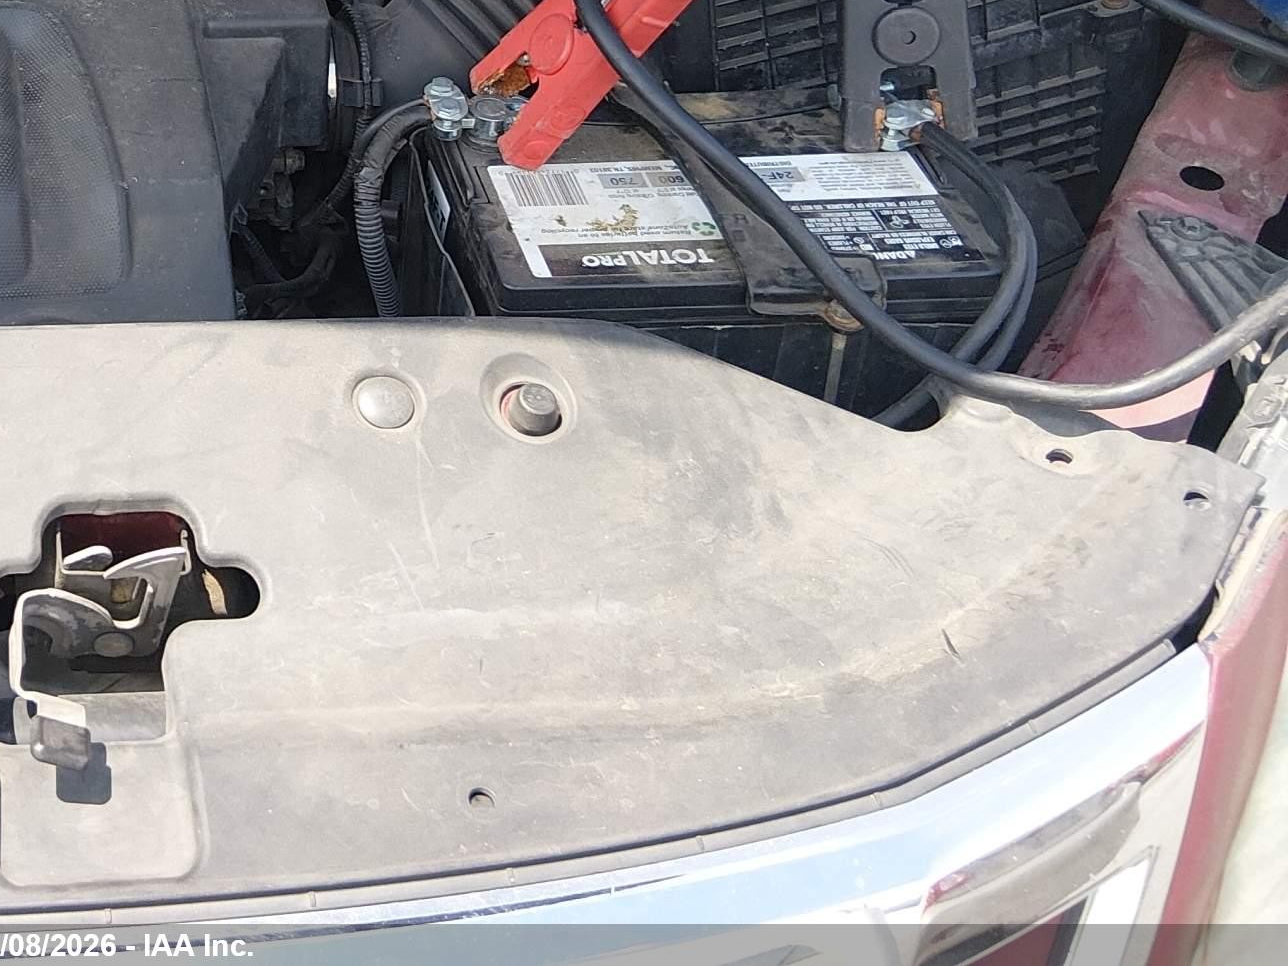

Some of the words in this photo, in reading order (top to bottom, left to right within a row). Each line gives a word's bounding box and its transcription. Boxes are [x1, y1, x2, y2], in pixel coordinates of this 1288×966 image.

[610, 177, 639, 186] 750
[658, 175, 685, 184] 600
[581, 248, 715, 268] TOTALPRO
